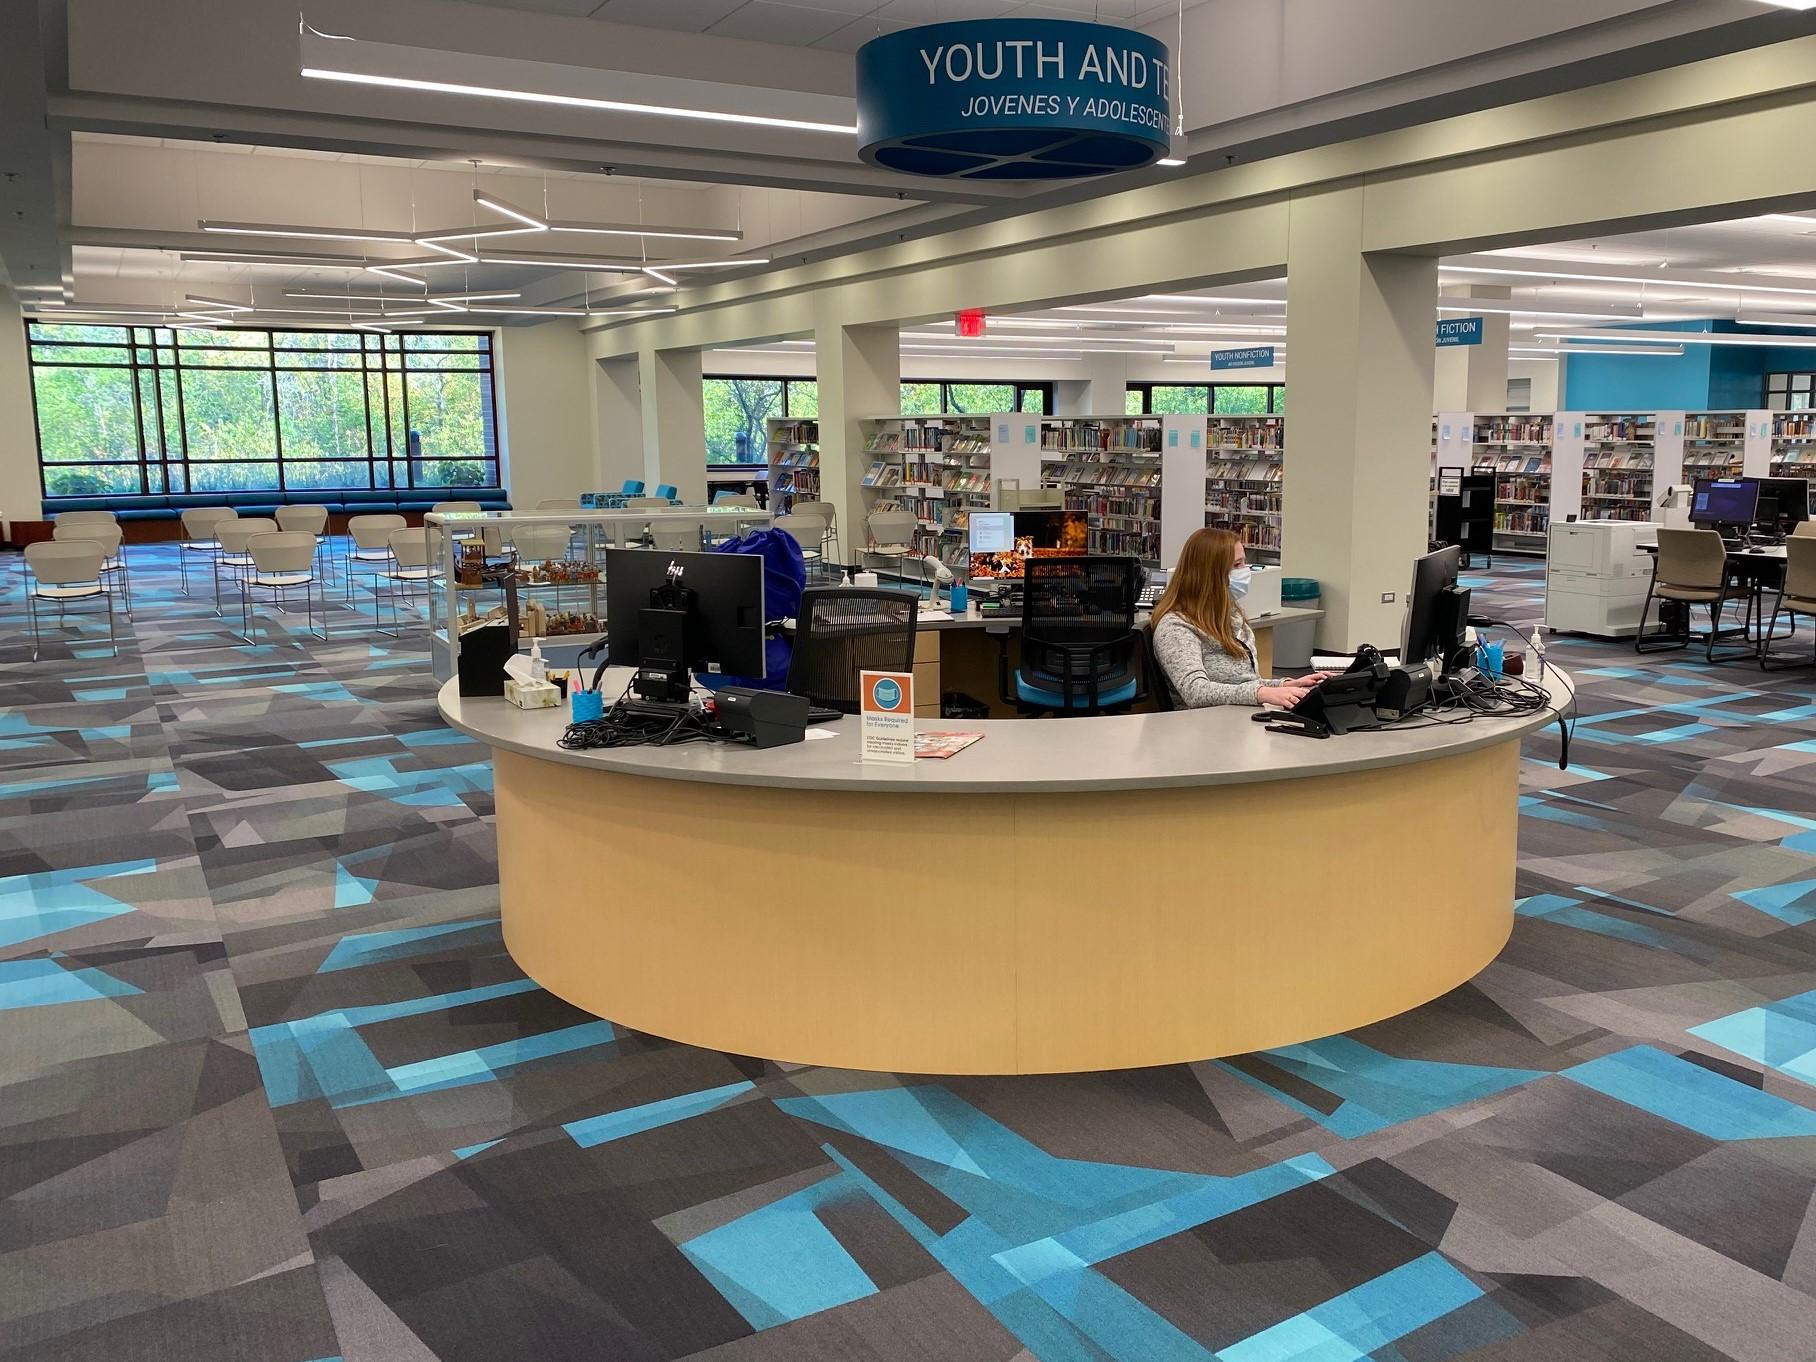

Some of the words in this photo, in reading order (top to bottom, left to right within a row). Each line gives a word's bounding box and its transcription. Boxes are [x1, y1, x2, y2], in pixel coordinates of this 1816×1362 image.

[919, 40, 1065, 85] YOUTH
[1078, 44, 1147, 89] AND
[960, 95, 1061, 117] JOVENES
[1067, 95, 1082, 116] Y
[1440, 322, 1476, 334] FICTION
[1214, 352, 1234, 361] YOUTH
[1234, 349, 1270, 360] NONFICTION
